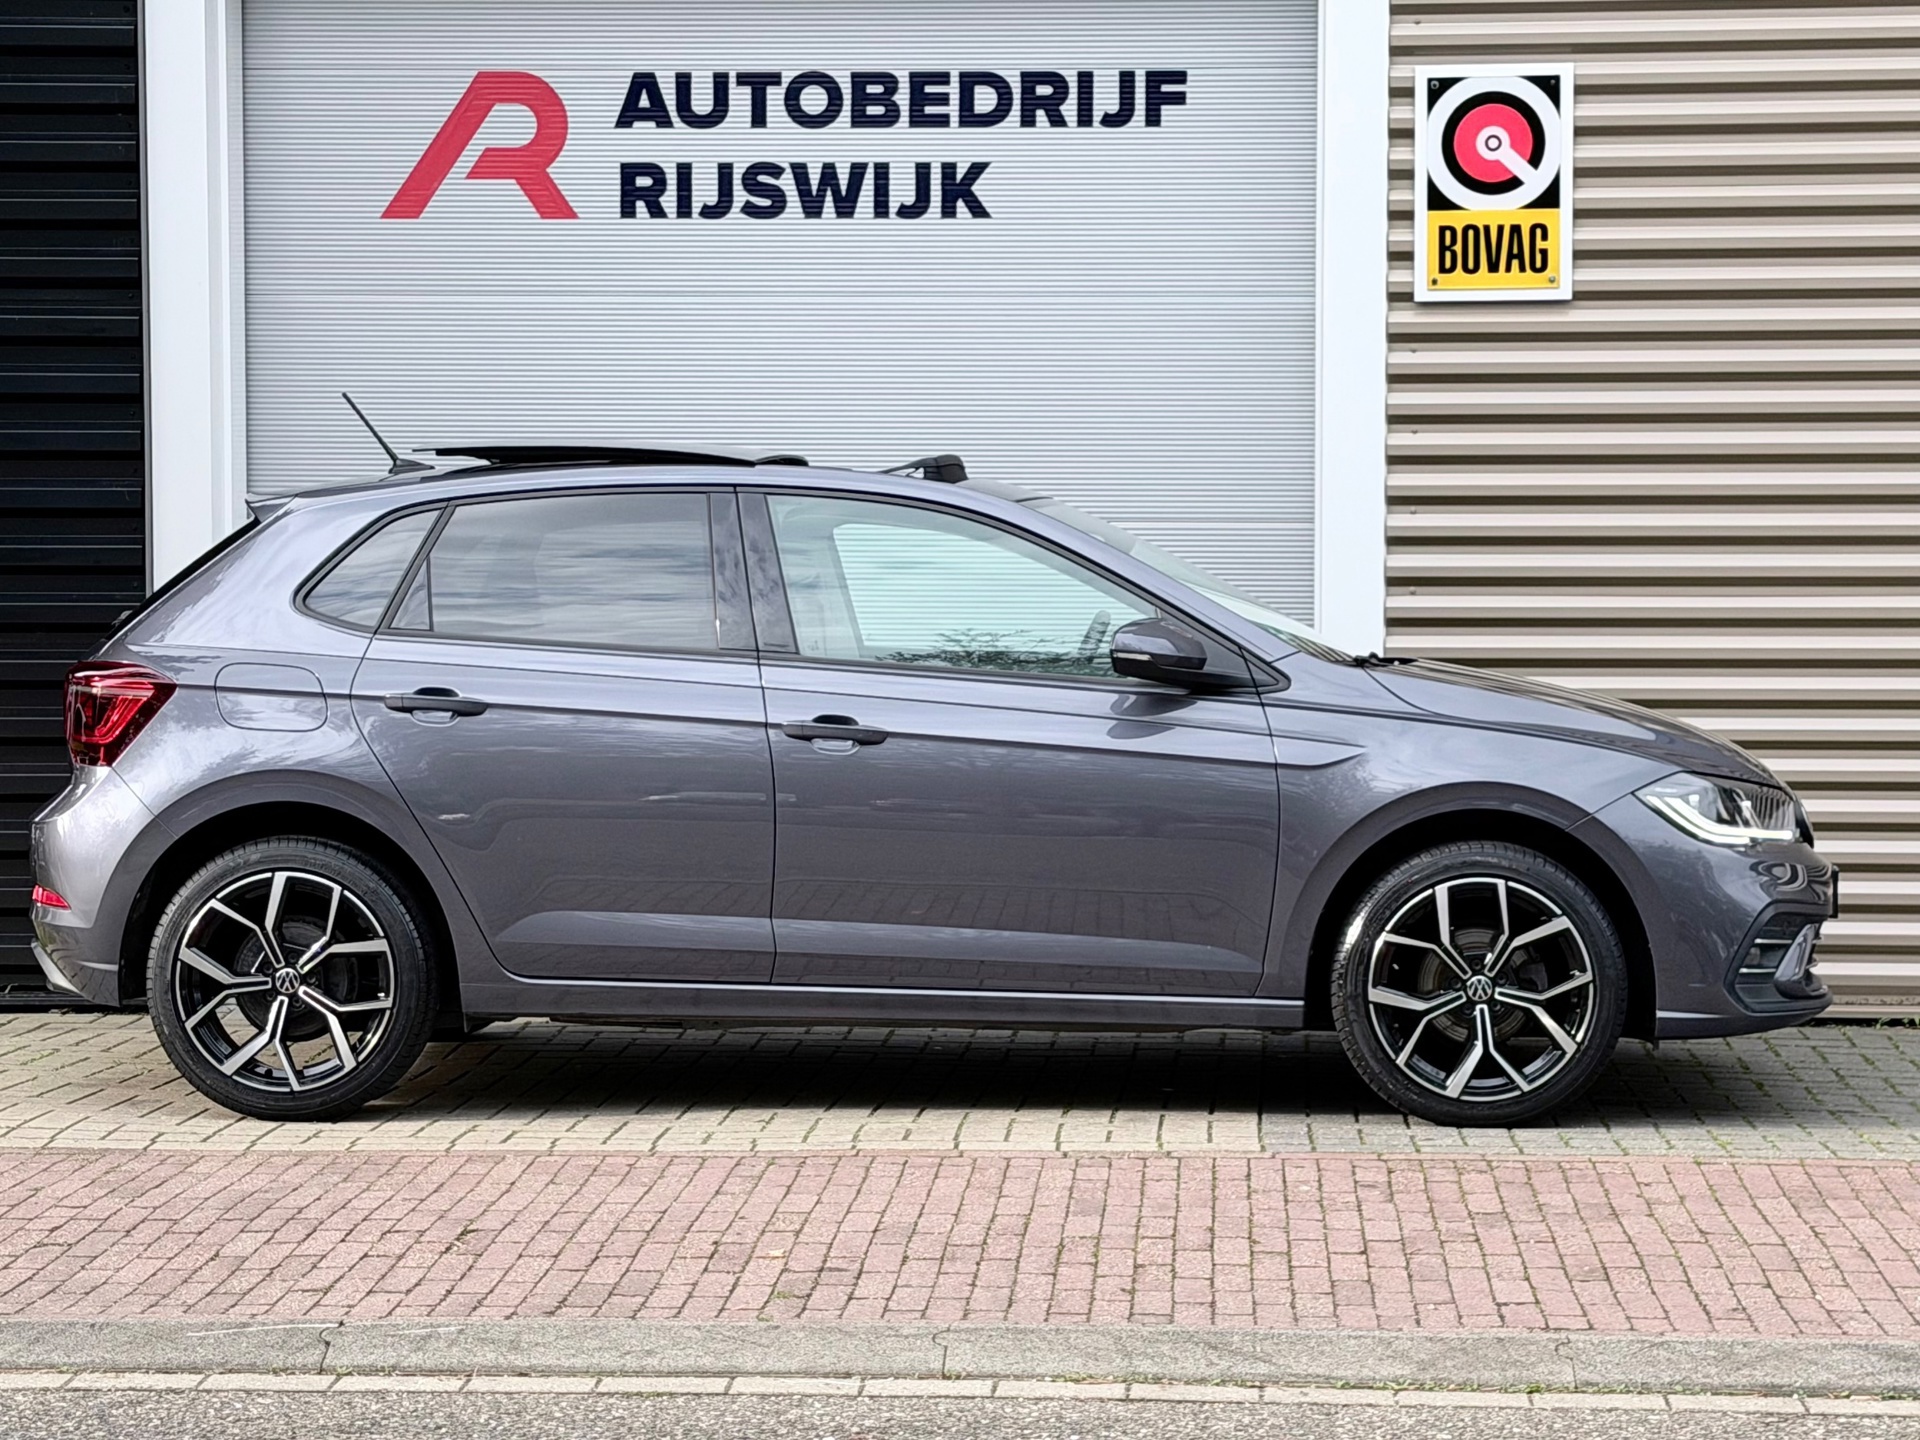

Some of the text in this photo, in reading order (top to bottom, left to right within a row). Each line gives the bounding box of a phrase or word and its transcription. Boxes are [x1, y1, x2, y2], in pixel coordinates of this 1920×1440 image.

[615, 70, 1188, 128] AUTOBEDRIJF
[620, 162, 991, 219] RIJSWIJK
[1438, 223, 1549, 274] BOVAG
